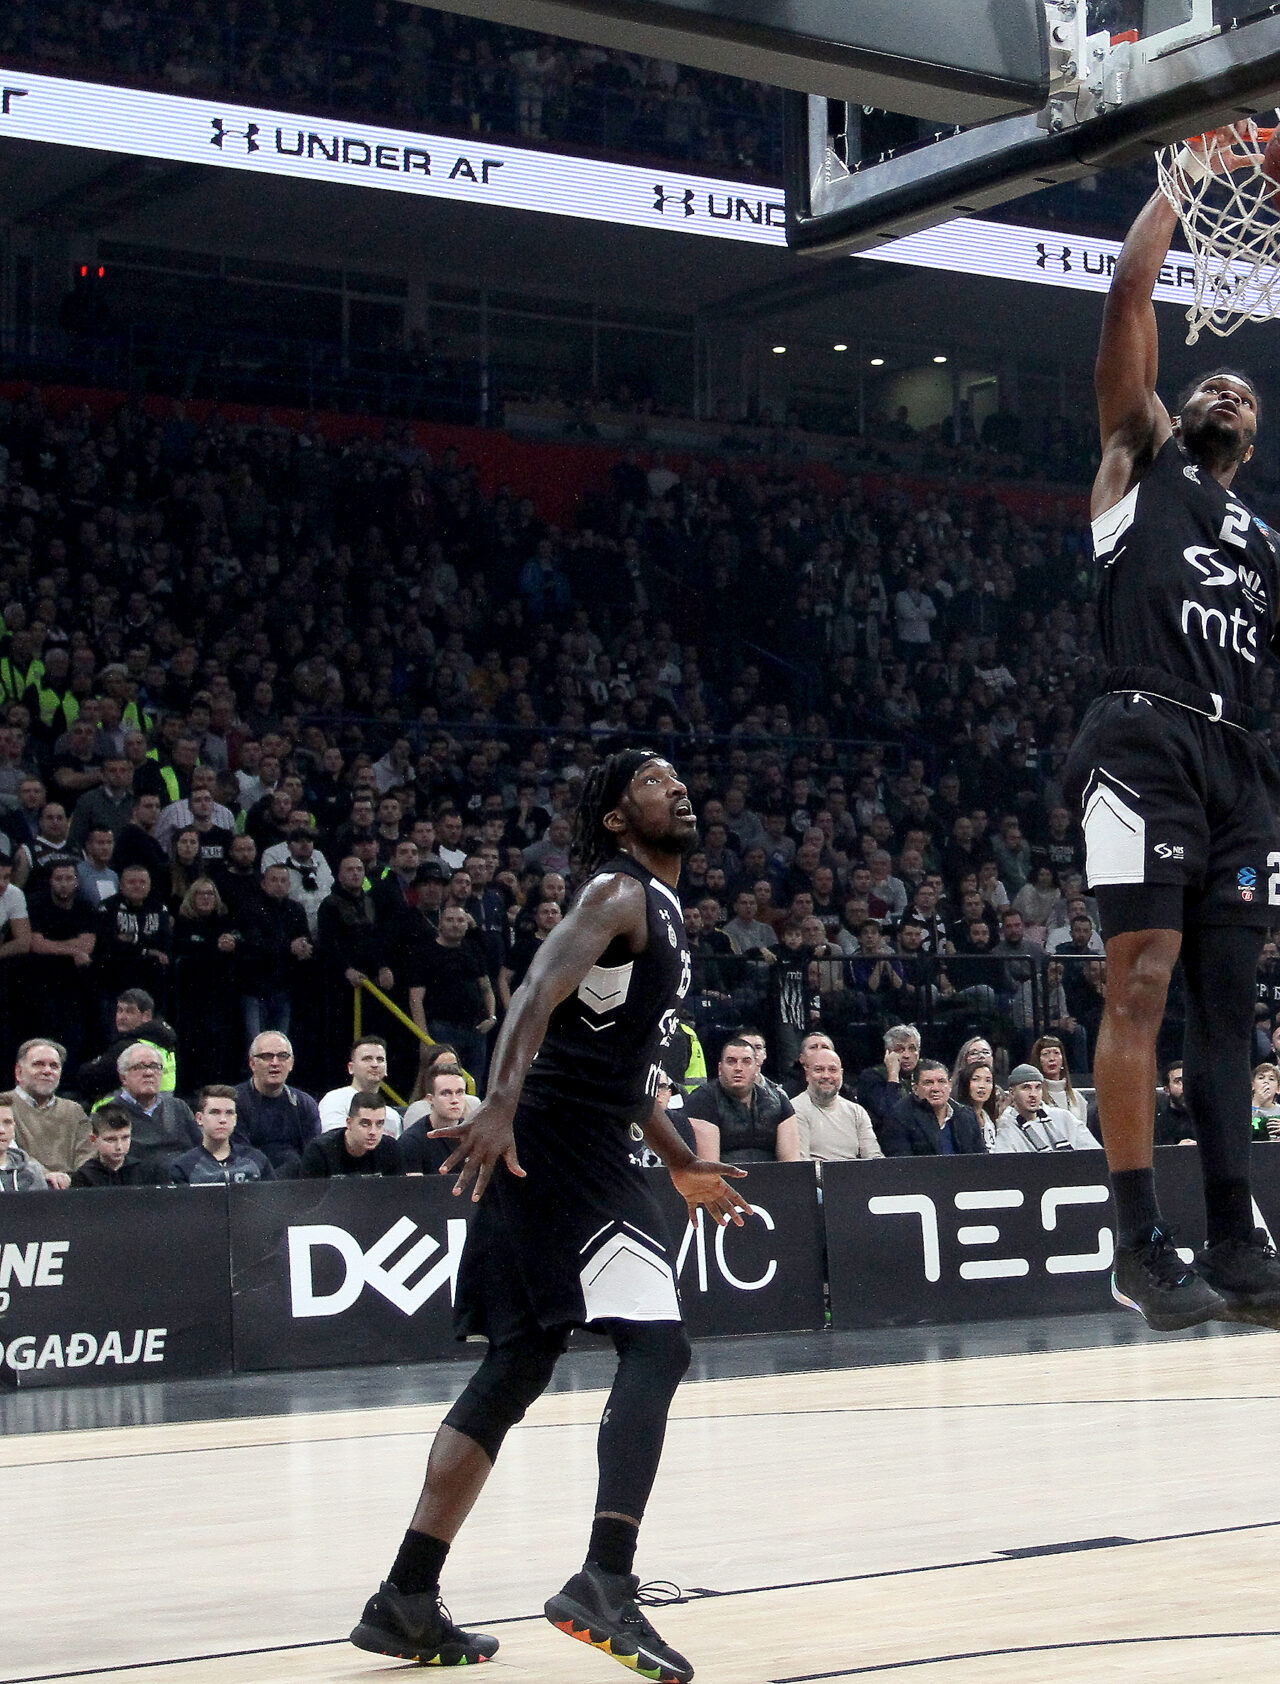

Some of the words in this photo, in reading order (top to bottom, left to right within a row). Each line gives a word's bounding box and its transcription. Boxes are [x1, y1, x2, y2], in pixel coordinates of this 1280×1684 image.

[275, 127, 432, 176] UNDER
[708, 194, 786, 228] UND
[1219, 503, 1251, 549] 2
[1239, 565, 1267, 598] NI
[1182, 600, 1256, 663] mts
[0, 1241, 70, 1288] NE
[0, 1328, 168, 1371] GAĐAJE
